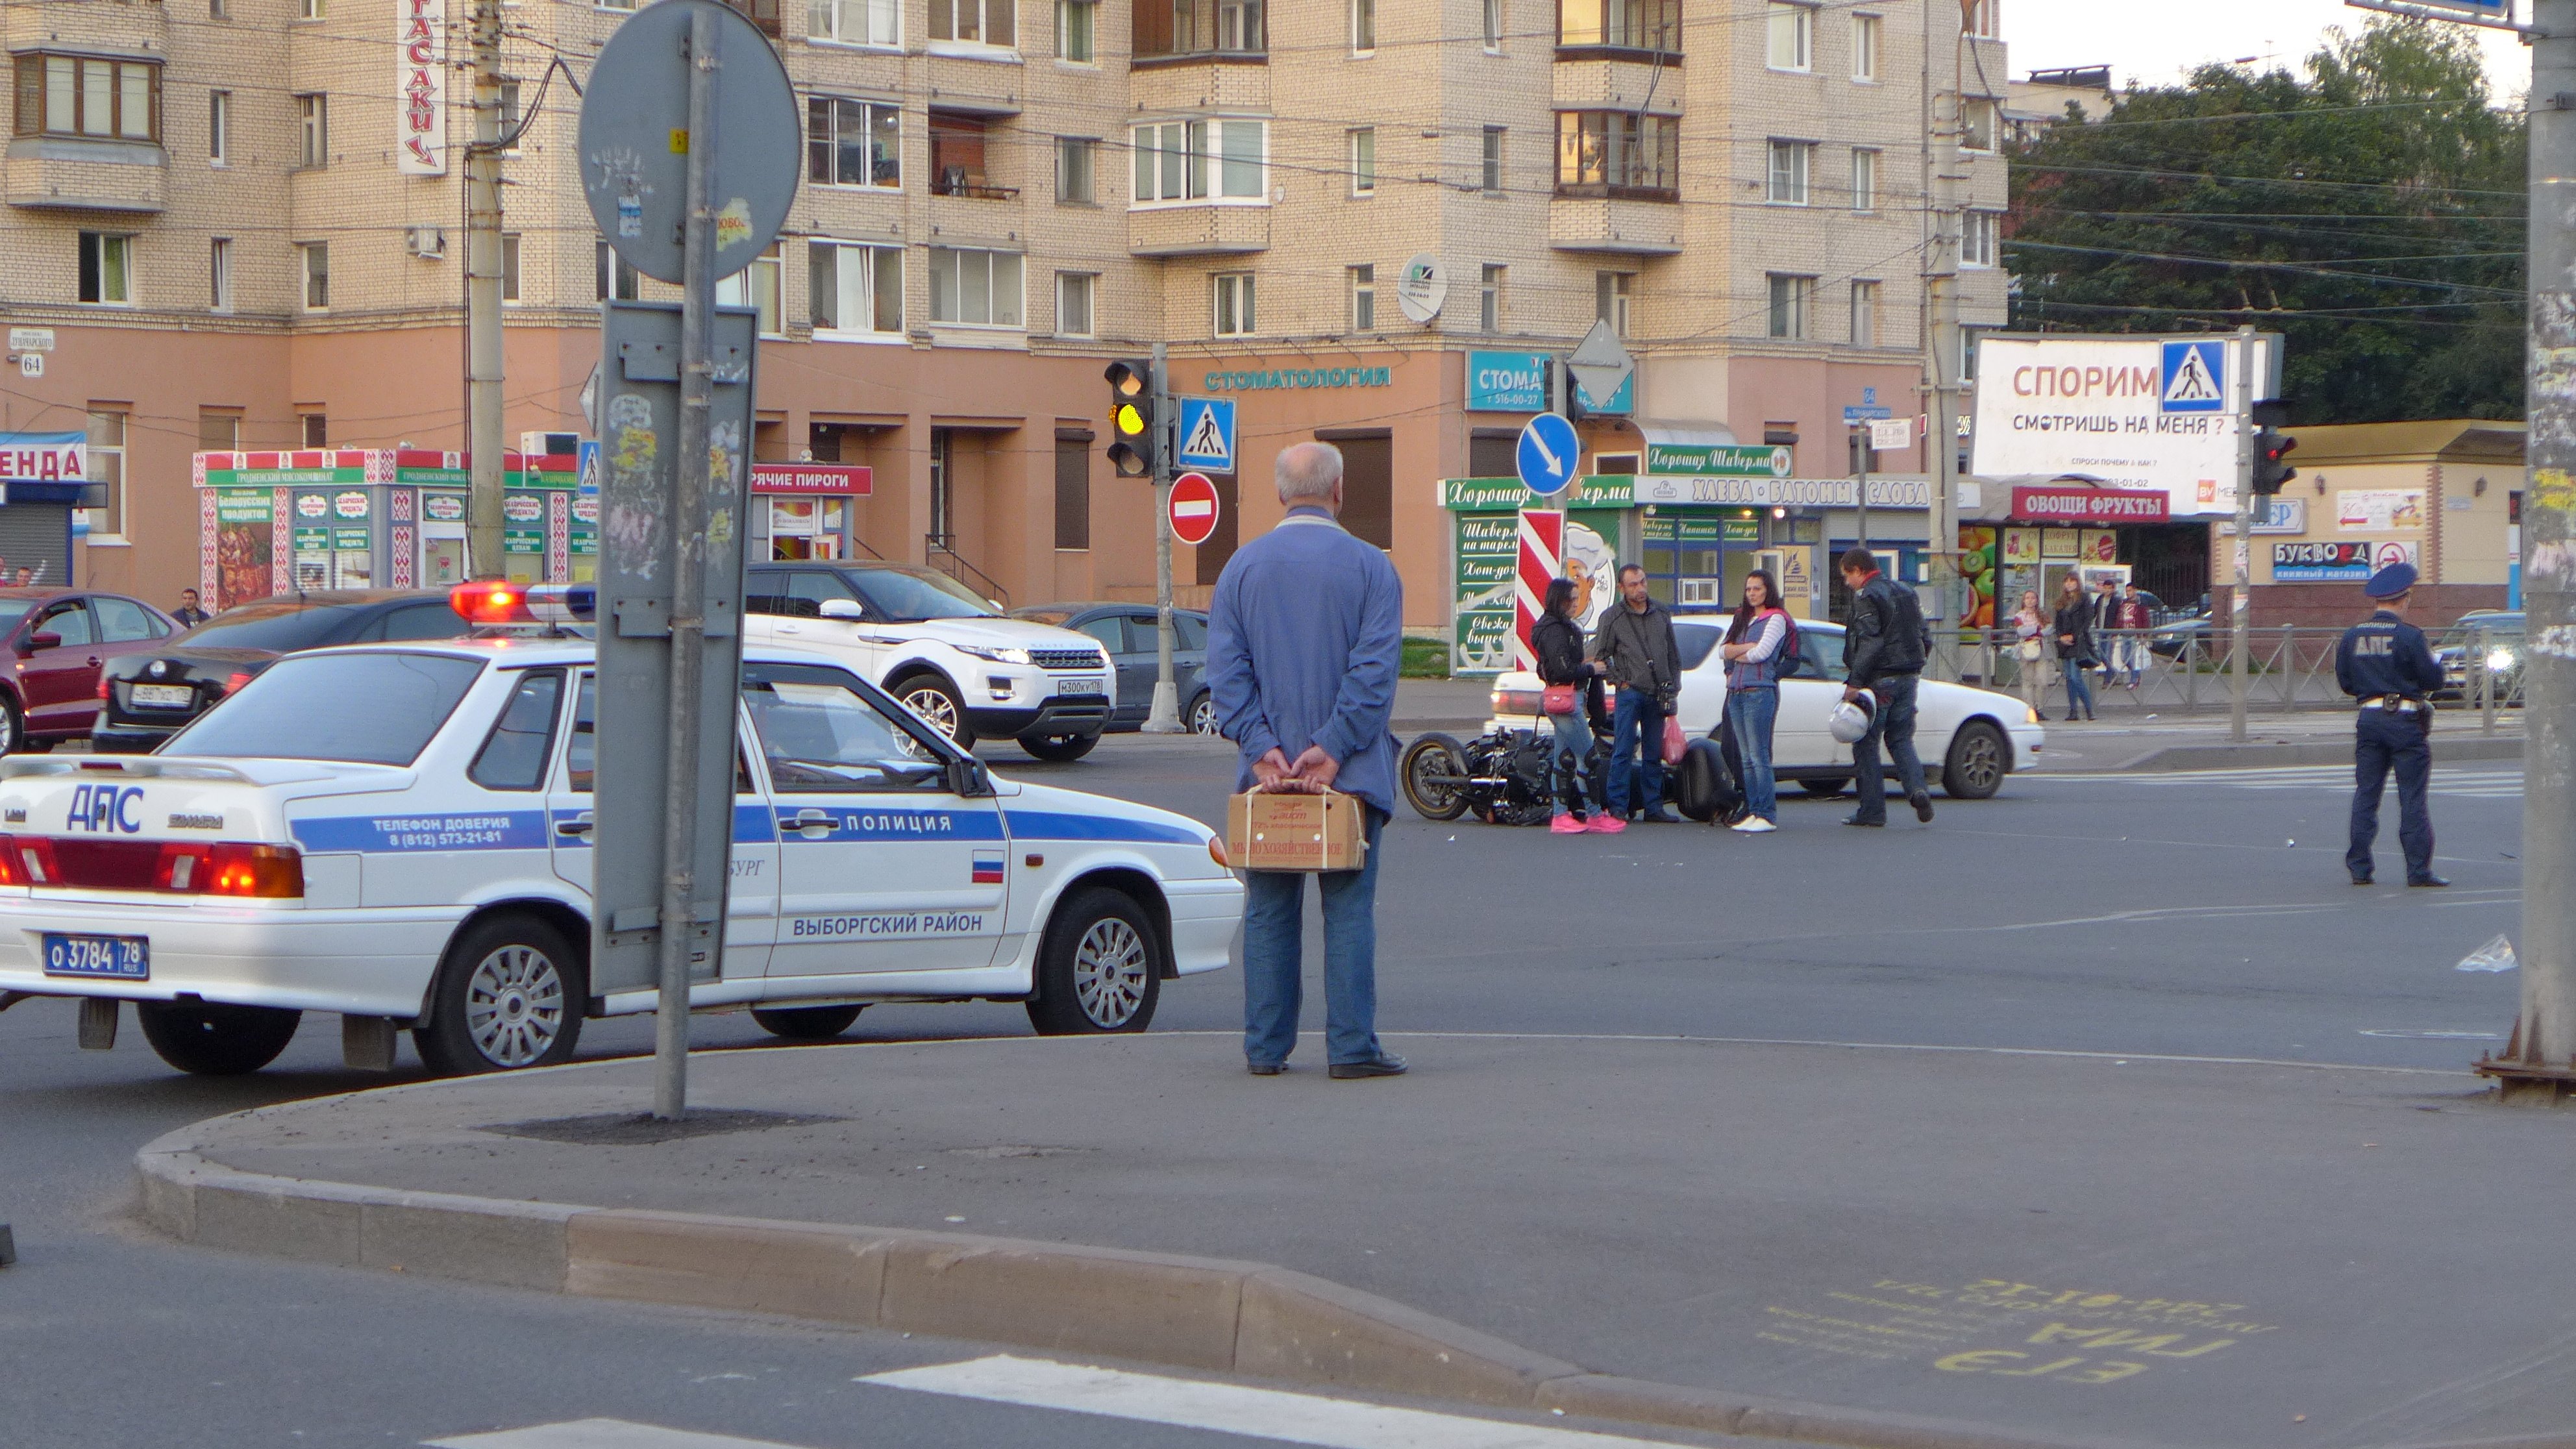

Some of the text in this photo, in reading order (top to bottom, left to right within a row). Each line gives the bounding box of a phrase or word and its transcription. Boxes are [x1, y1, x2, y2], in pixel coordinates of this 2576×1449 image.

[24, 357, 40, 371] 64
[1205, 367, 1391, 391] СТОМАТОЛОГИЯ
[2014, 365, 2158, 397] СПОРИМ
[1494, 394, 1539, 405] 516-00-27
[2014, 415, 2118, 433] СМОТРИШЬ
[2125, 415, 2149, 434] НА
[2155, 415, 2208, 434] МЕНЯ
[0, 451, 81, 481] ЕНДА
[1650, 447, 1770, 471] Хорошая Шаверма
[236, 471, 333, 483] ГРОДНЕНСКИЙ МЯСОКОМБИНАТ
[403, 471, 449, 482] ГРОДНЕНСКИЙ
[796, 473, 848, 487] ПИРОГИ
[1449, 481, 1532, 507] Хорошая
[1868, 482, 1928, 505] СДОБА
[2025, 495, 2162, 515] ОВОЩИ ФРУКТЫ
[1463, 541, 1477, 550] на
[2277, 568, 2323, 578] книжный
[66, 784, 144, 834] ДПС
[372, 817, 512, 832] ТЕЛЕФОН ДОВЕРИЯ
[847, 815, 952, 834] ПОЛИЦИЯ
[390, 830, 502, 848] 8 (812) 573-21-81
[793, 911, 982, 936] ВЫБОРГСКИЙ РАЙОН
[67, 940, 113, 970] 3784
[121, 941, 140, 963] 78
[123, 963, 137, 972] RUS
